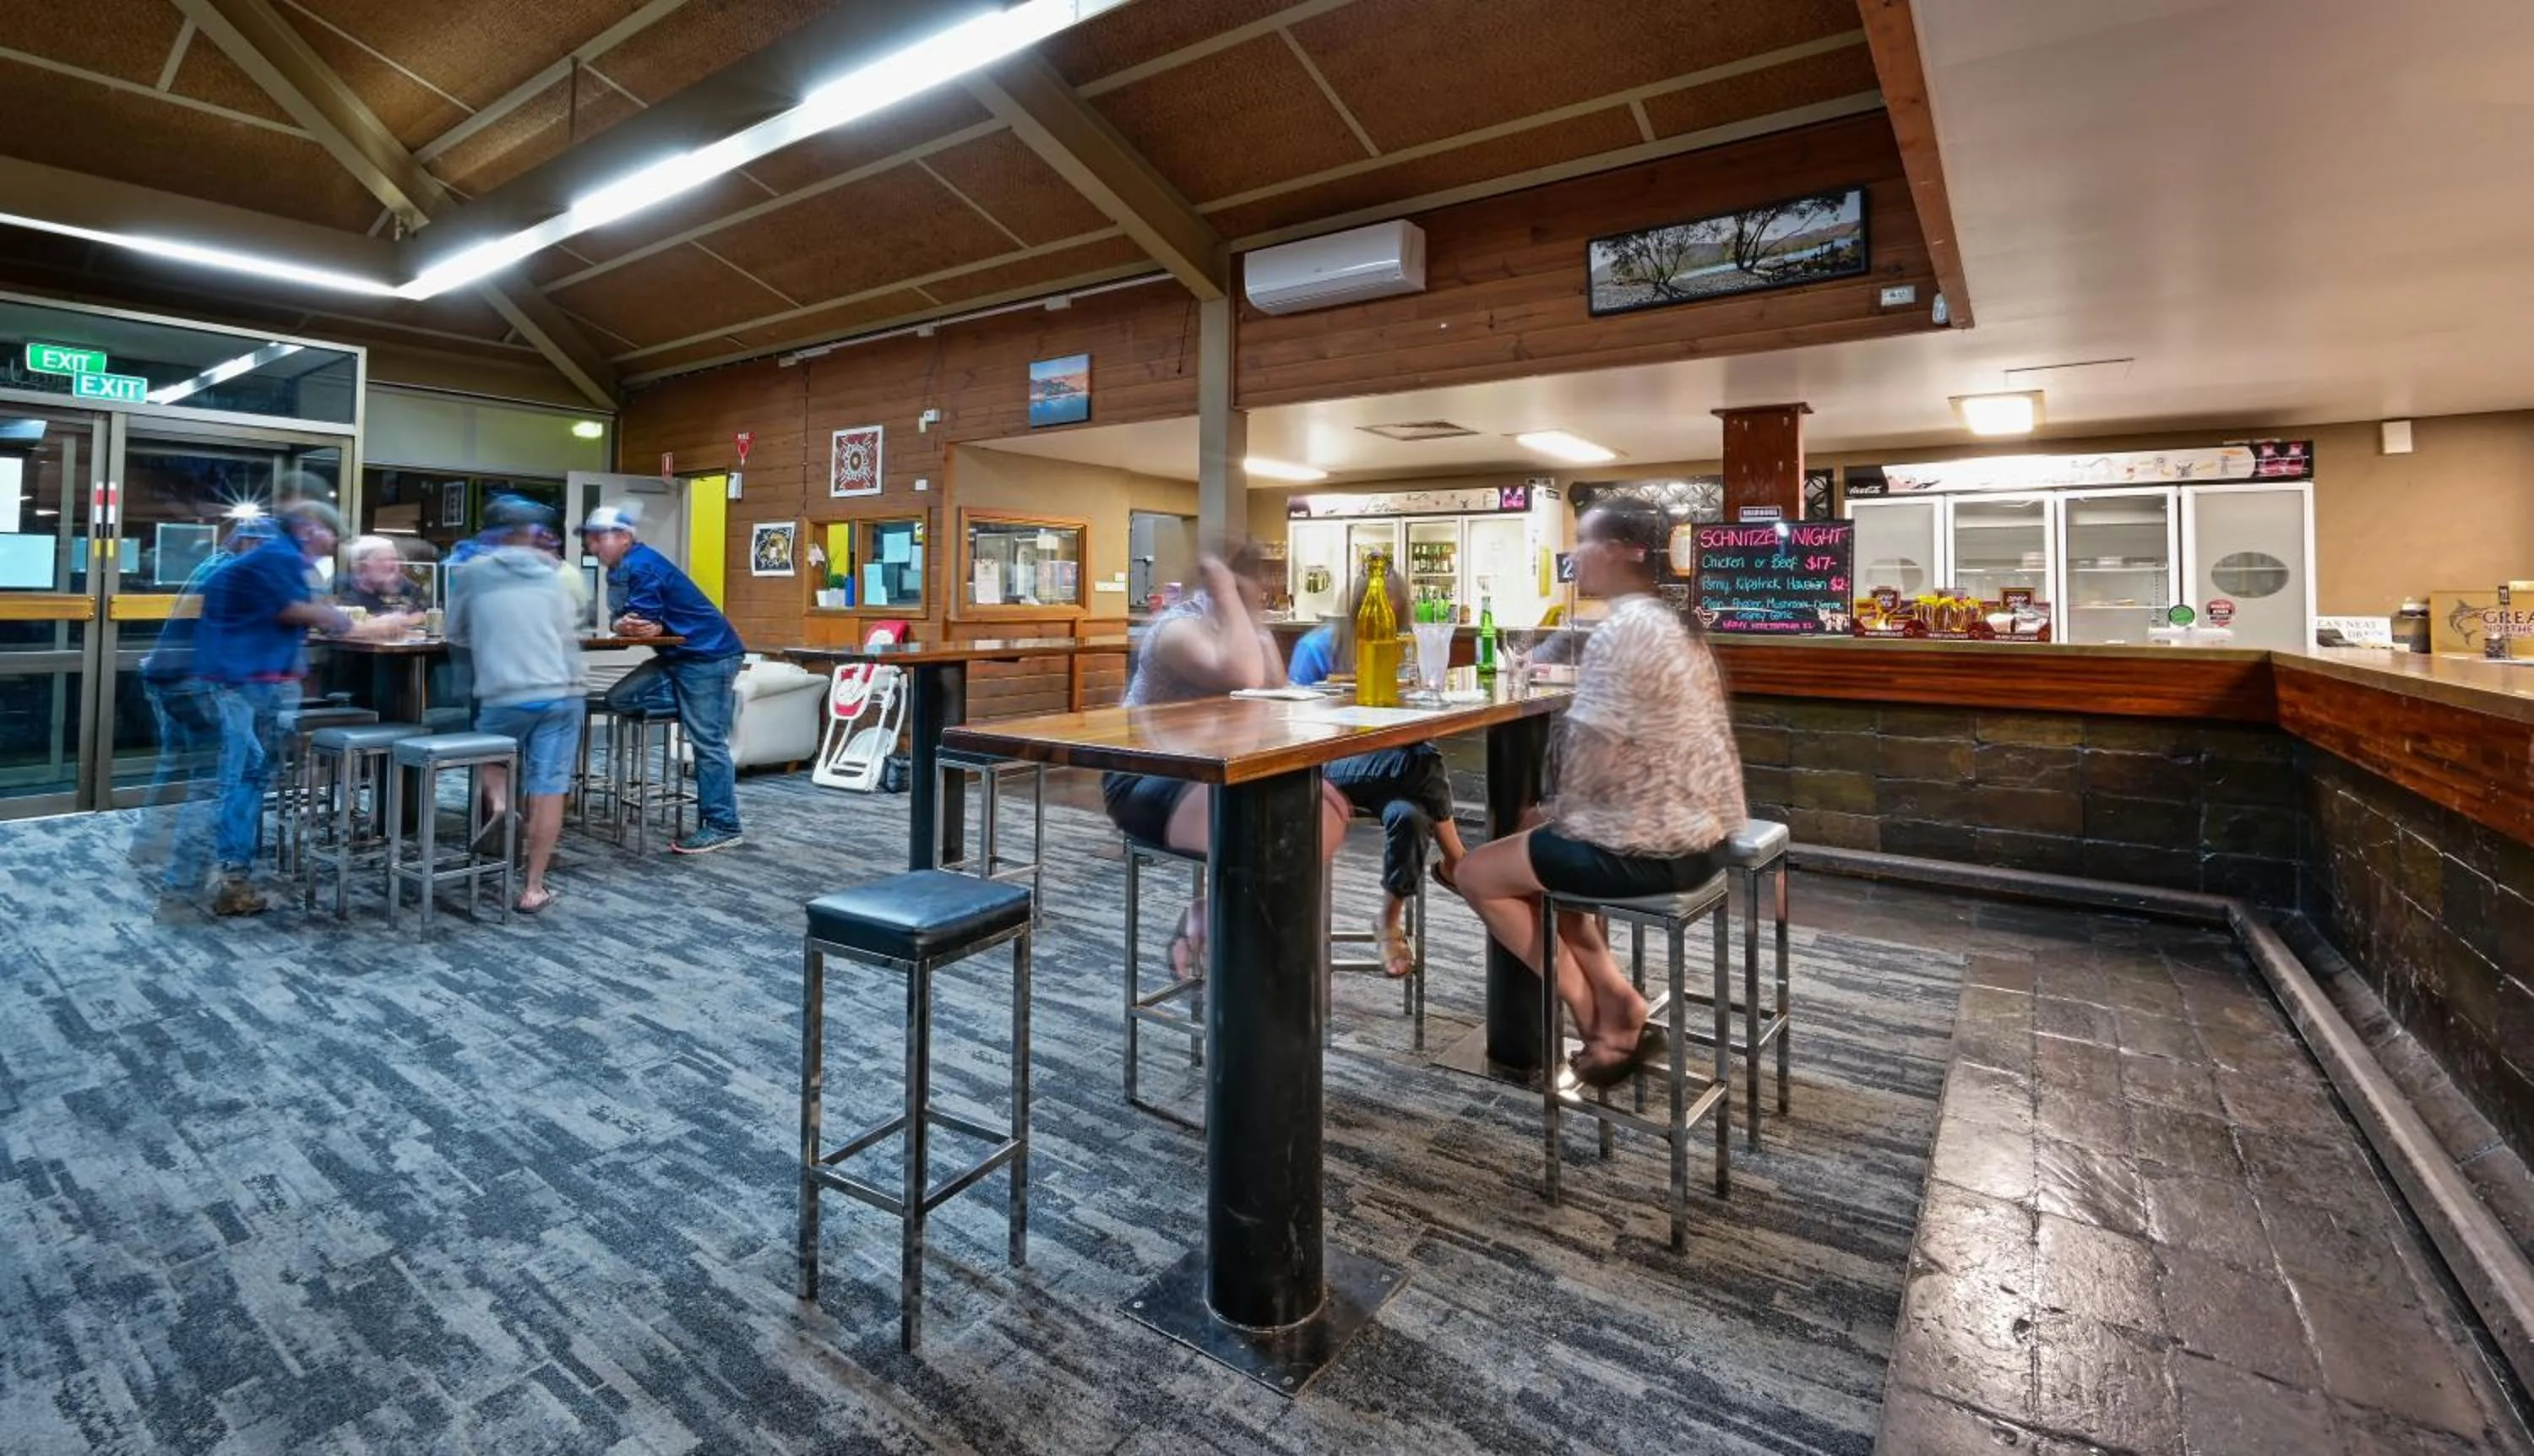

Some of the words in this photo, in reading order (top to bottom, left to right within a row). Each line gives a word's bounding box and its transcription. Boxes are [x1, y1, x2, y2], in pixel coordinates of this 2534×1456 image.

[43, 350, 92, 372] EXIT
[81, 375, 140, 399] EXIT
[1700, 528, 1783, 548] SCHNITZEL
[1792, 526, 1849, 546] NIGHT
[1702, 553, 1744, 568] Chicken
[1754, 557, 1765, 568] or
[1771, 554, 1798, 571] Beef
